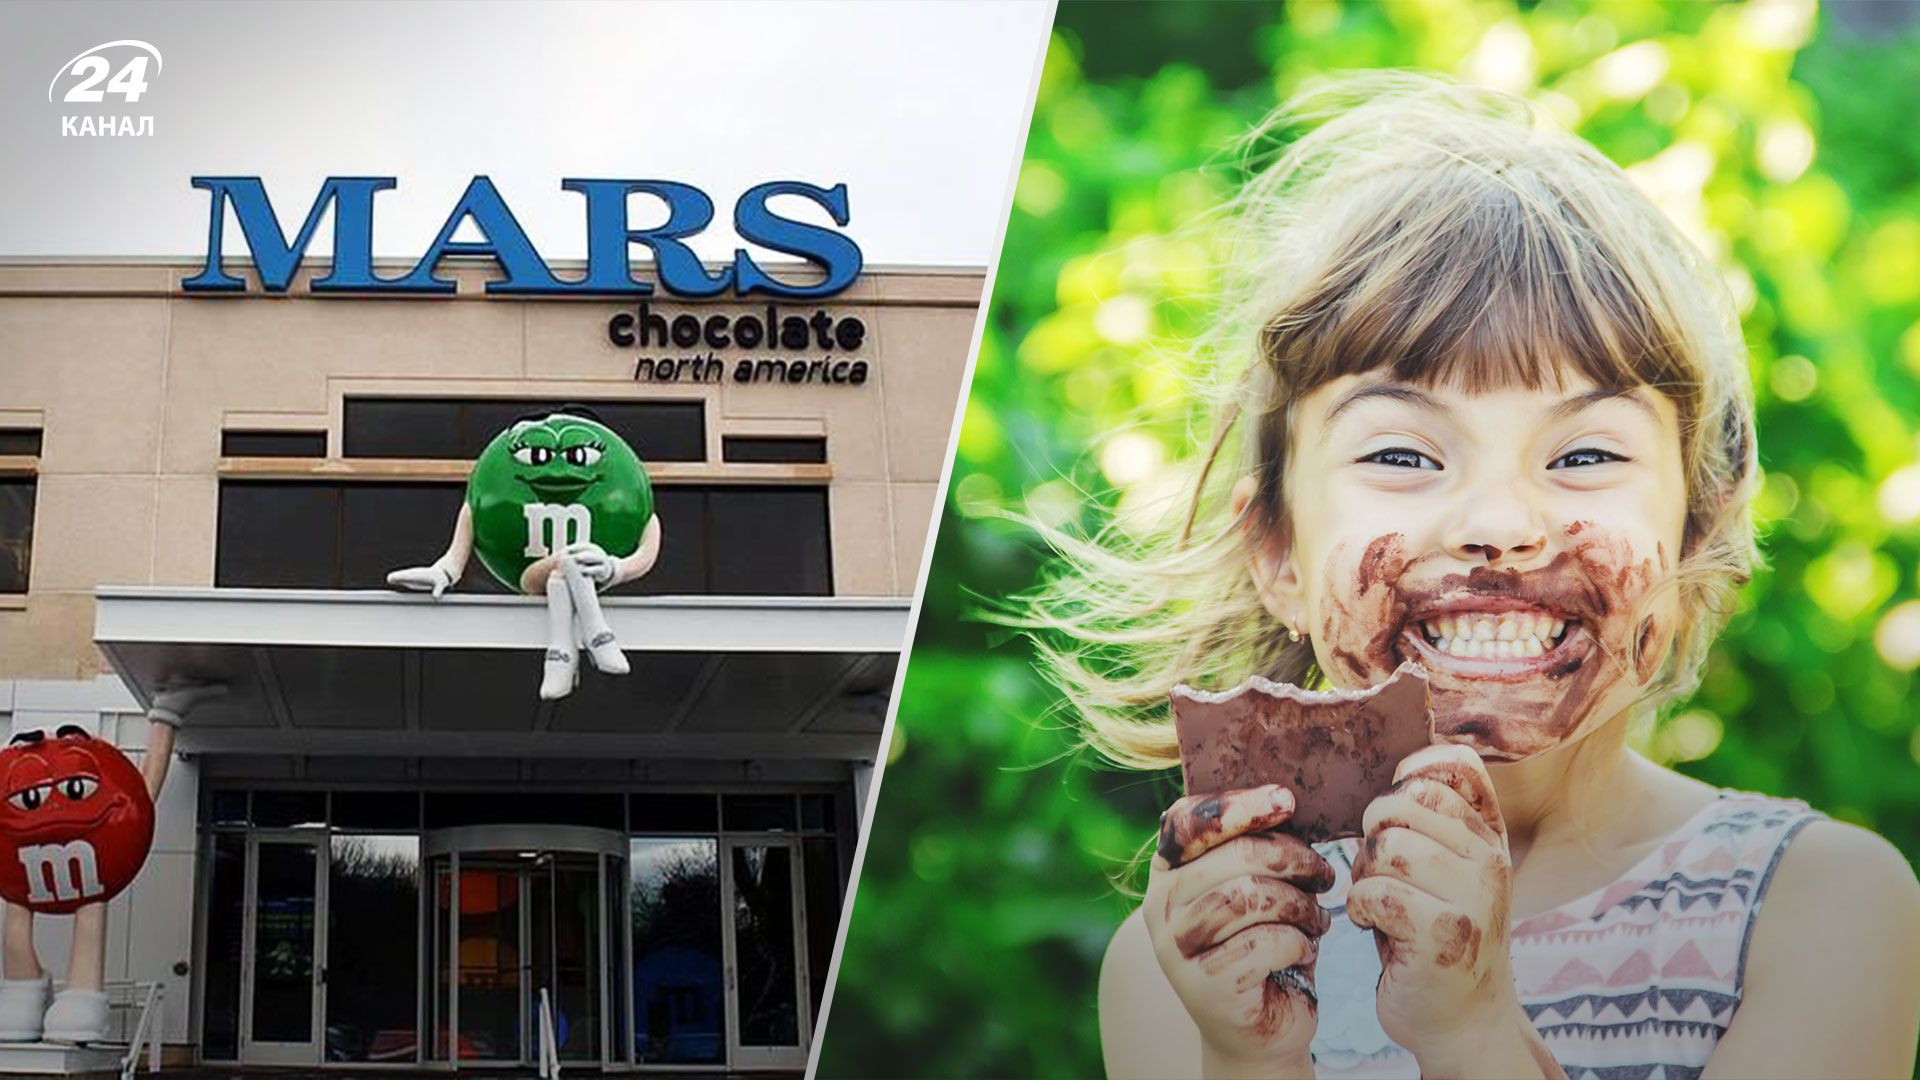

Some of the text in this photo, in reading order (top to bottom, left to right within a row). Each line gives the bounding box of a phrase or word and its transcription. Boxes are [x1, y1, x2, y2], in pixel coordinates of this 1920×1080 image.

[182, 175, 864, 298] MARS
[608, 303, 866, 351] chocolate
[634, 353, 869, 386] north america
[523, 502, 592, 558] m
[17, 838, 105, 904] m
